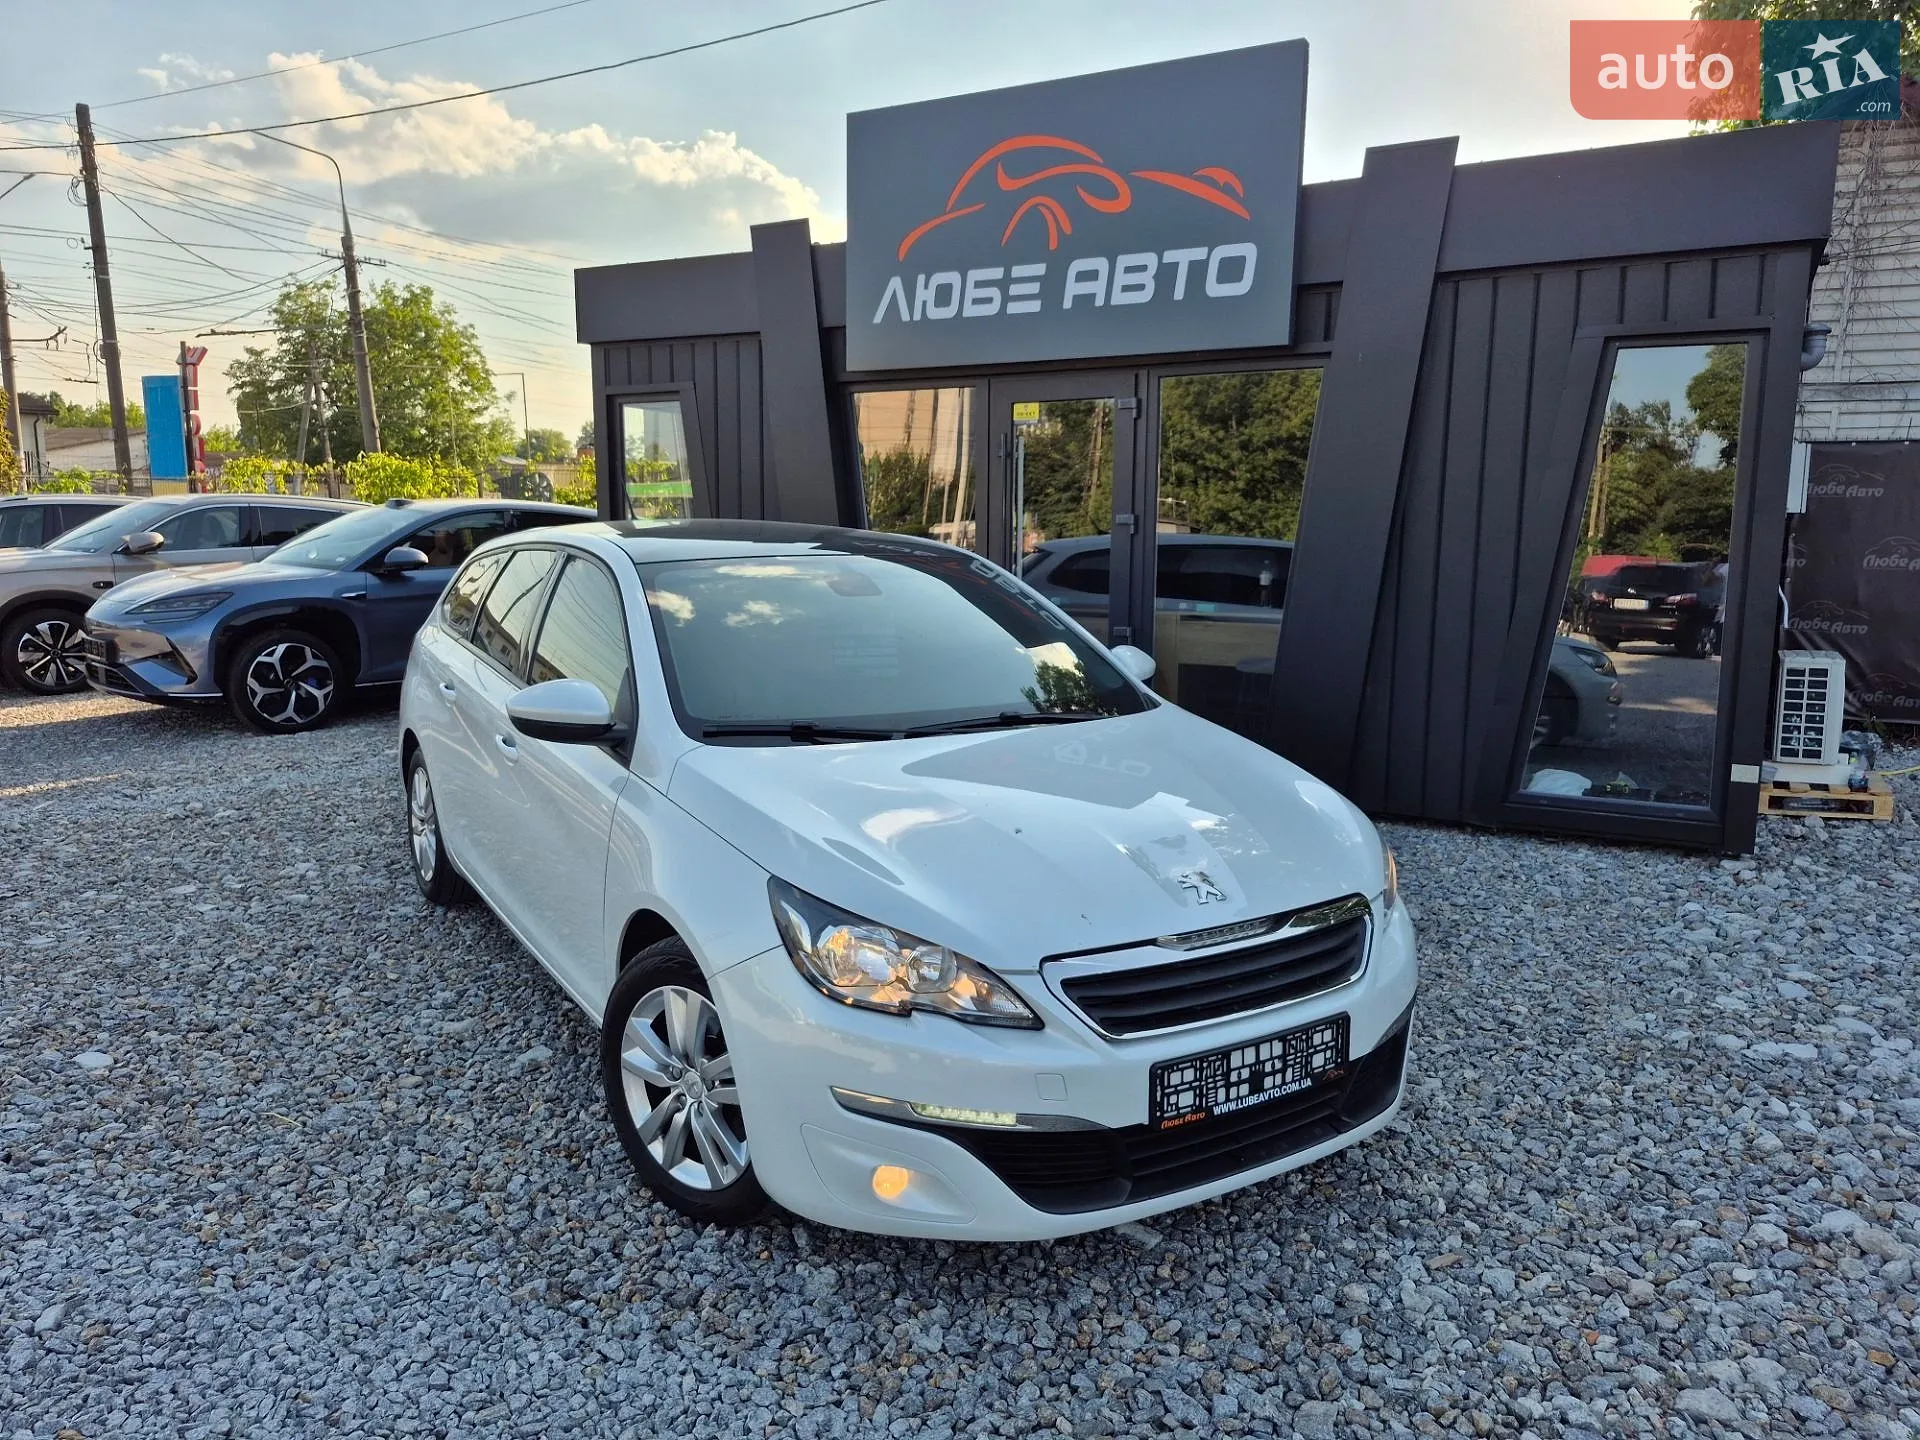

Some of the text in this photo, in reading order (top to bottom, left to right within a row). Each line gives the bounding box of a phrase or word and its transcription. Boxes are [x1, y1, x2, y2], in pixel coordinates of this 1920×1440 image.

[873, 242, 1258, 324] ЛЮБЕ АВТО
[1213, 1077, 1313, 1116] WWW.LUBEAVTO.COM.UA
